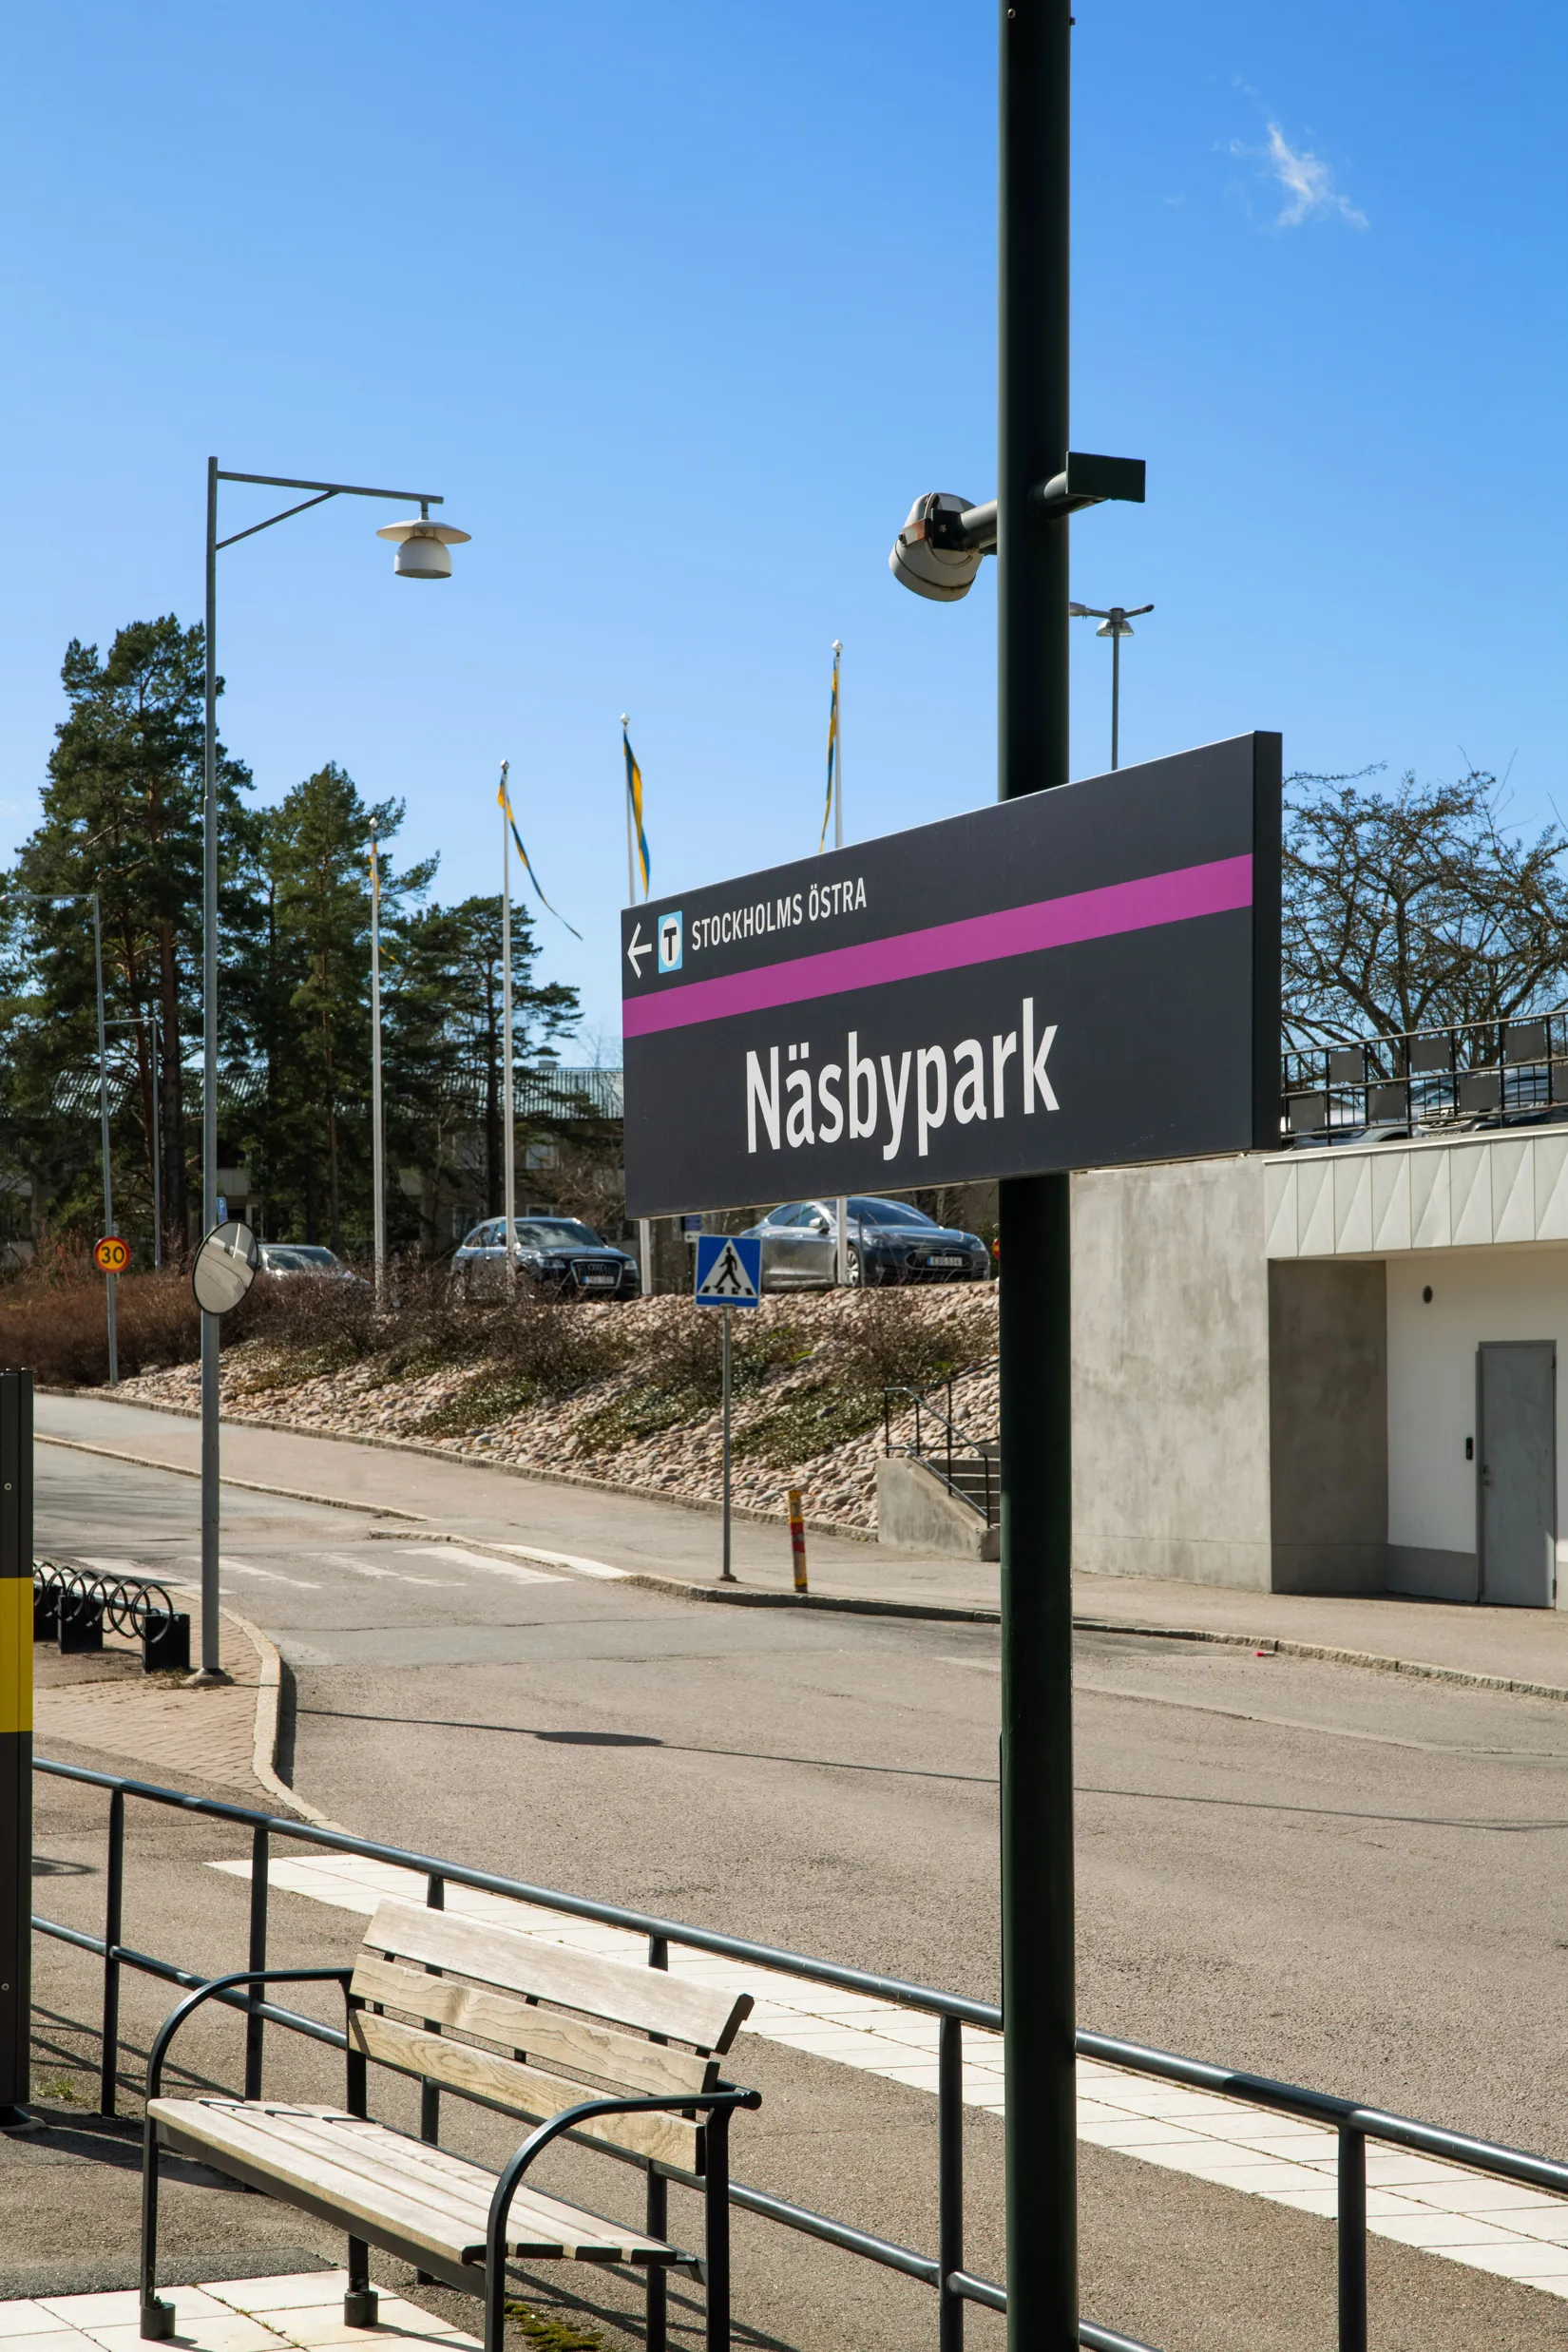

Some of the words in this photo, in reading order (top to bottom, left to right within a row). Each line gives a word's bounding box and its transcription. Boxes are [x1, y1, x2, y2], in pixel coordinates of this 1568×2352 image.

[663, 926, 678, 962] T
[692, 893, 802, 950] STOCKHOLMS
[809, 877, 867, 922] ÖSTRA
[746, 997, 1060, 1160] Näsbypark
[101, 1246, 124, 1264] 30
